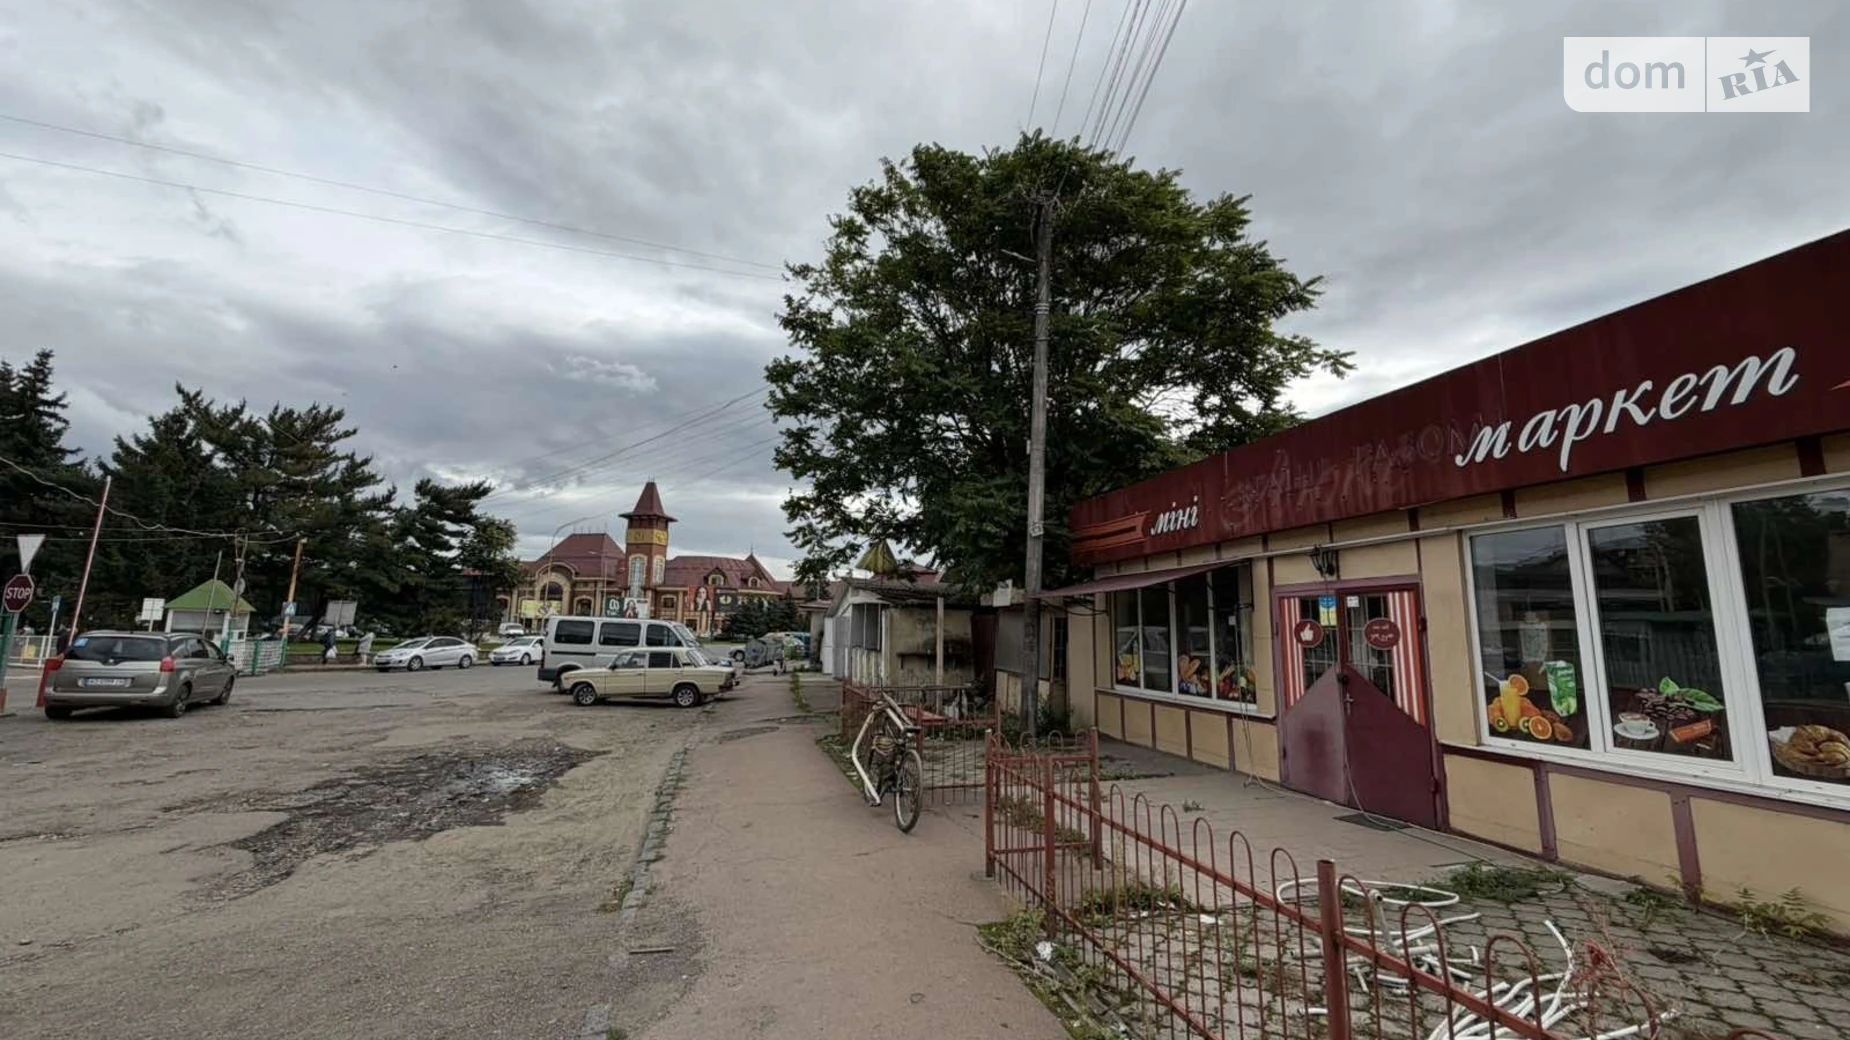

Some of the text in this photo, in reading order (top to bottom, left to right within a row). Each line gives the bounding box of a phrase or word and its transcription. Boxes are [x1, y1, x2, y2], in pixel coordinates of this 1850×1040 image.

[1150, 346, 1800, 536] міні маркет
[6, 587, 31, 599] STOP
